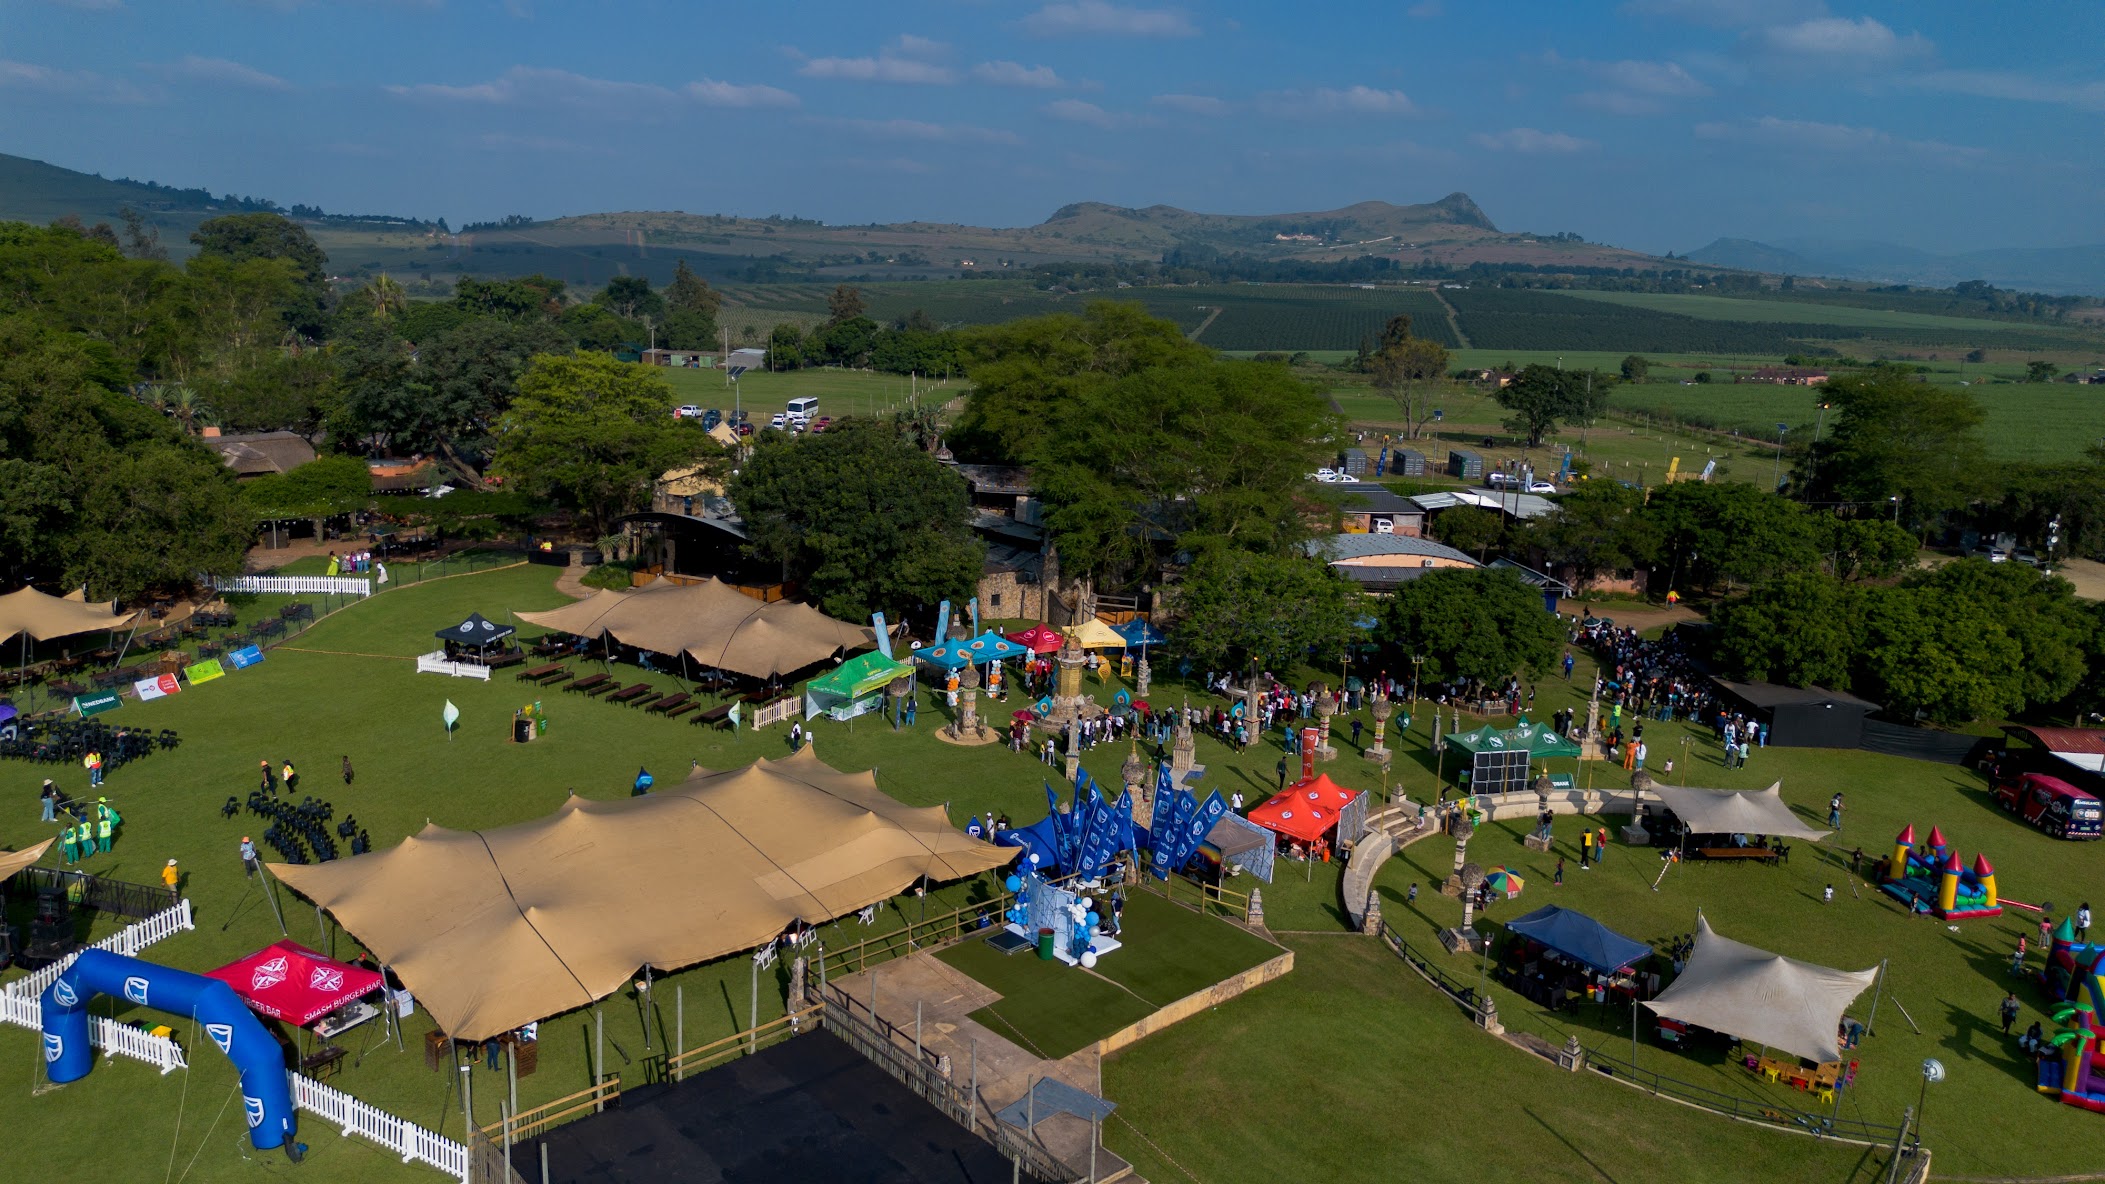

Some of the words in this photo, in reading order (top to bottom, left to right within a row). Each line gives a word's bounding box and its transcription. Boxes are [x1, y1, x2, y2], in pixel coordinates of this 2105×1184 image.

[88, 696, 115, 707] NEDBANK
[304, 1004, 332, 1021] SMASH
[333, 987, 365, 1008] BURGER
[366, 979, 381, 994] BAR
[266, 1003, 281, 1018] BAR
